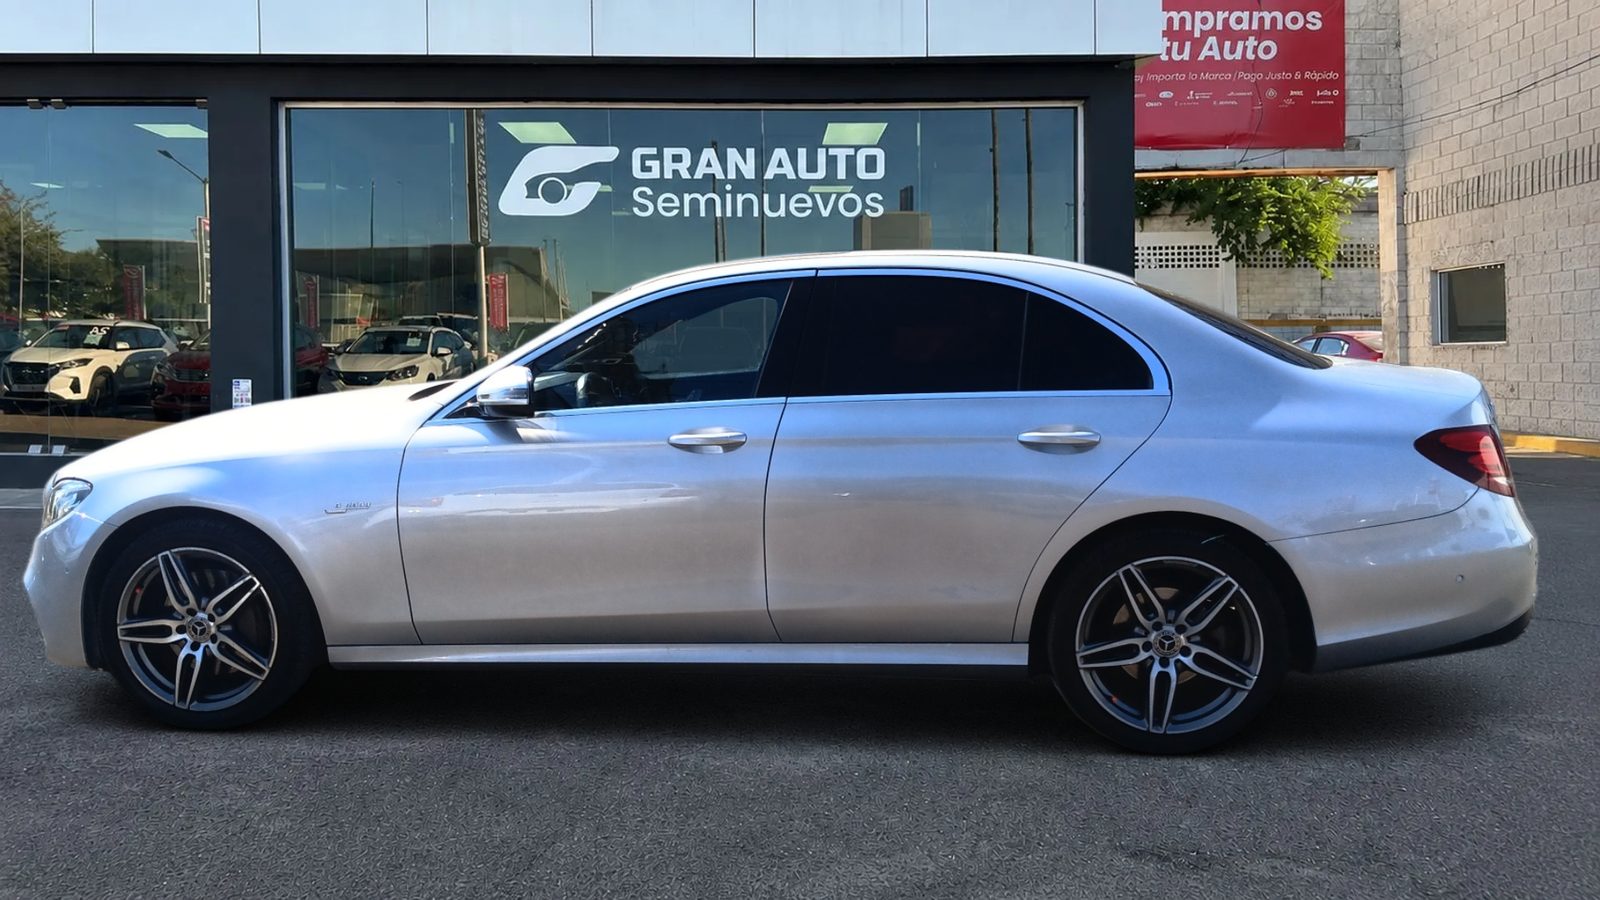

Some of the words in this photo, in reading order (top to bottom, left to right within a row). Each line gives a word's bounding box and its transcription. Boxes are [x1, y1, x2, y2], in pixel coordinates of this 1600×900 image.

[1160, 36, 1191, 61] tu
[1197, 35, 1278, 61] Auto
[1146, 73, 1186, 83] Importa
[1188, 72, 1198, 81] la
[1200, 72, 1232, 81] Marca
[1265, 71, 1292, 80] Justo
[1294, 71, 1301, 80] &
[631, 147, 756, 180] GRAN
[764, 147, 886, 180] AUTO
[631, 183, 885, 218] Seminuevos
